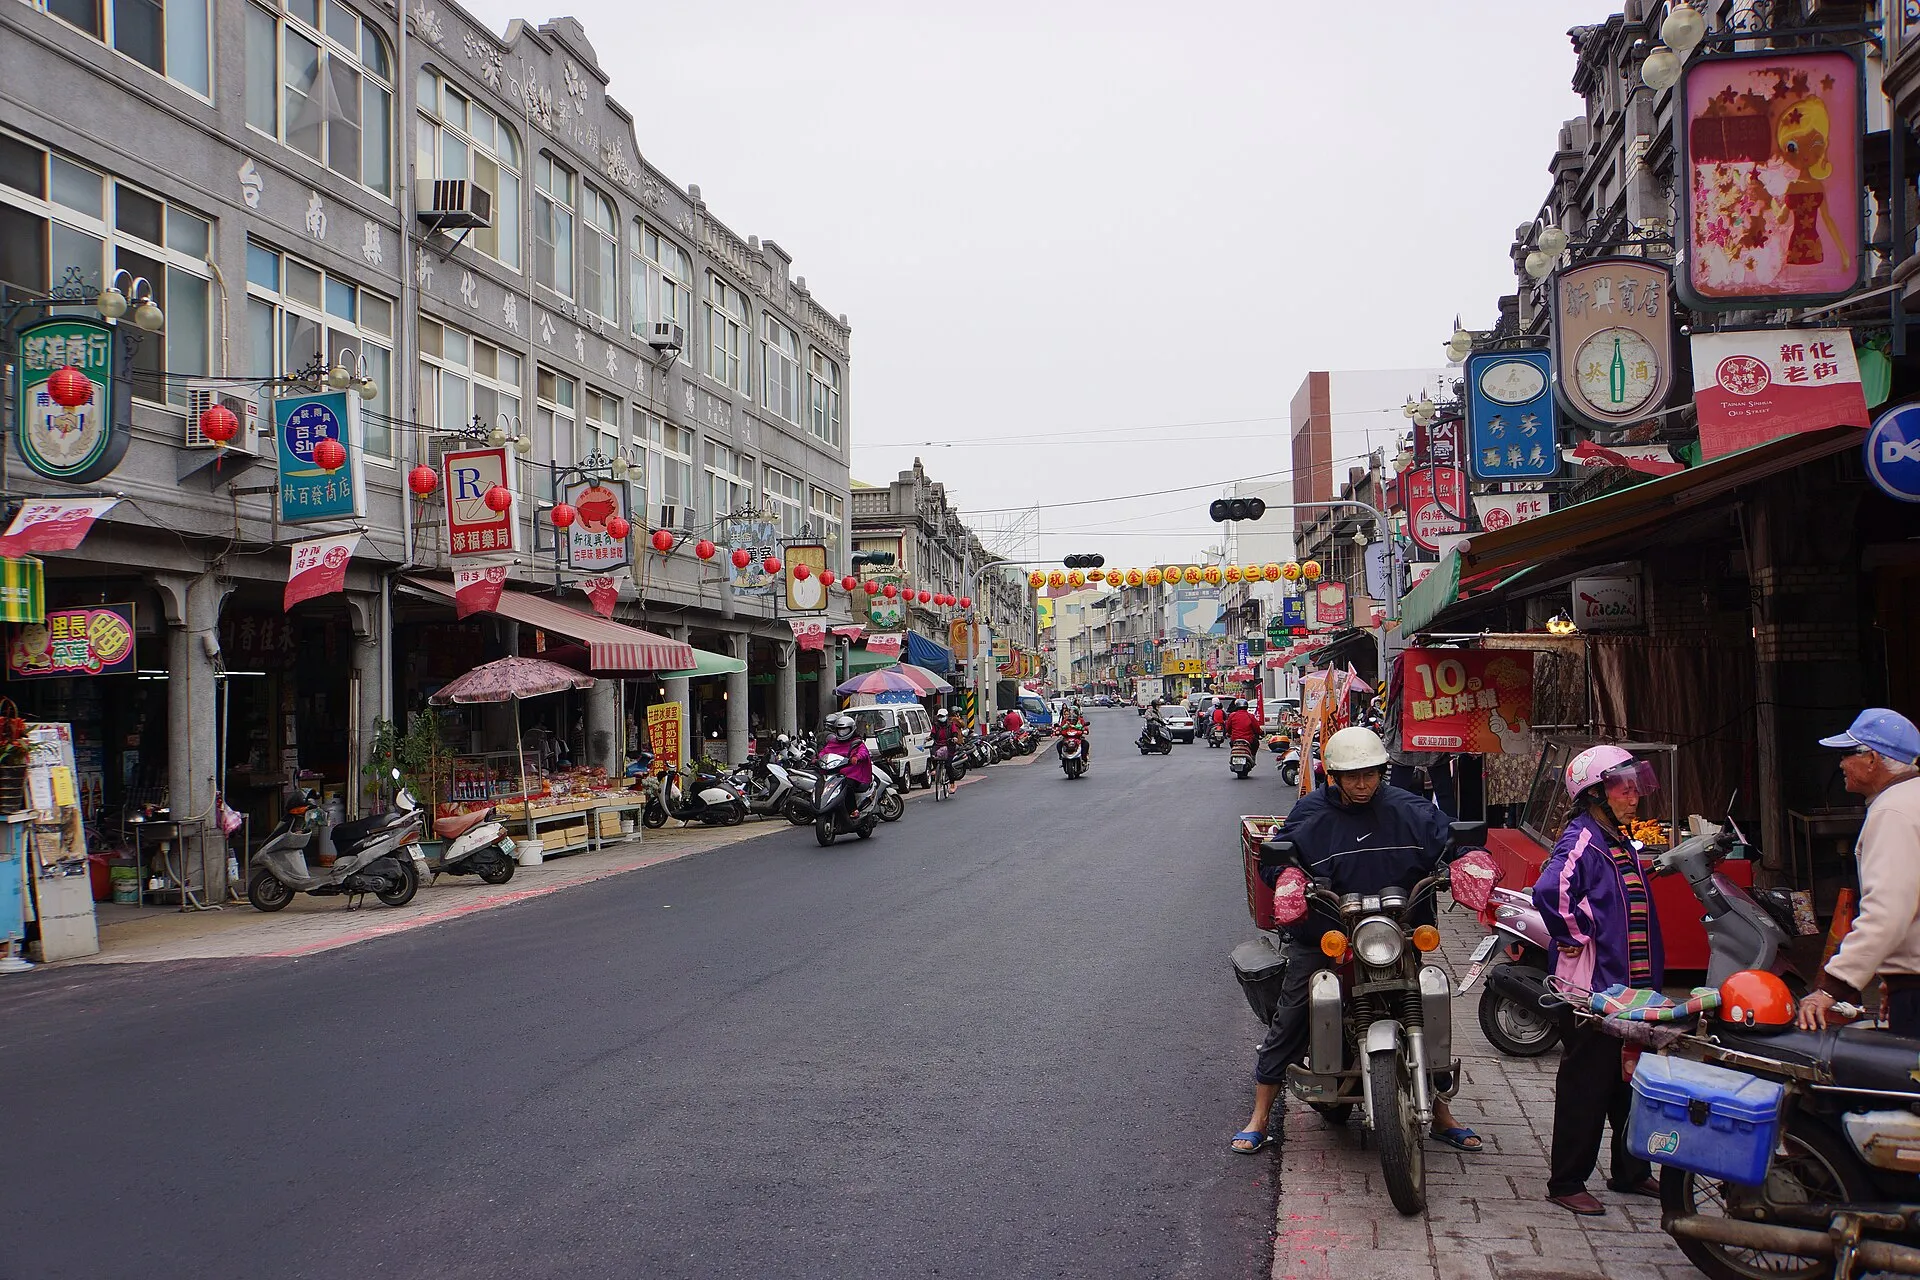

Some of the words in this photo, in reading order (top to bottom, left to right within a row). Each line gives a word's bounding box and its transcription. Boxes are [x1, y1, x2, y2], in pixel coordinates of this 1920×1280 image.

[1566, 275, 1661, 320] 新興商店
[1780, 342, 1836, 362] 新化
[1783, 361, 1839, 383] 老街
[295, 424, 328, 439] 百貨
[453, 468, 483, 500] R
[1516, 501, 1541, 514] 新化
[52, 614, 87, 640] 里長
[51, 639, 90, 667] 茶葉
[1415, 659, 1466, 699] 10
[1469, 679, 1480, 688] 元
[1412, 688, 1499, 720] 脆皮炸雞
[1417, 736, 1458, 747] 歡迎加盟
